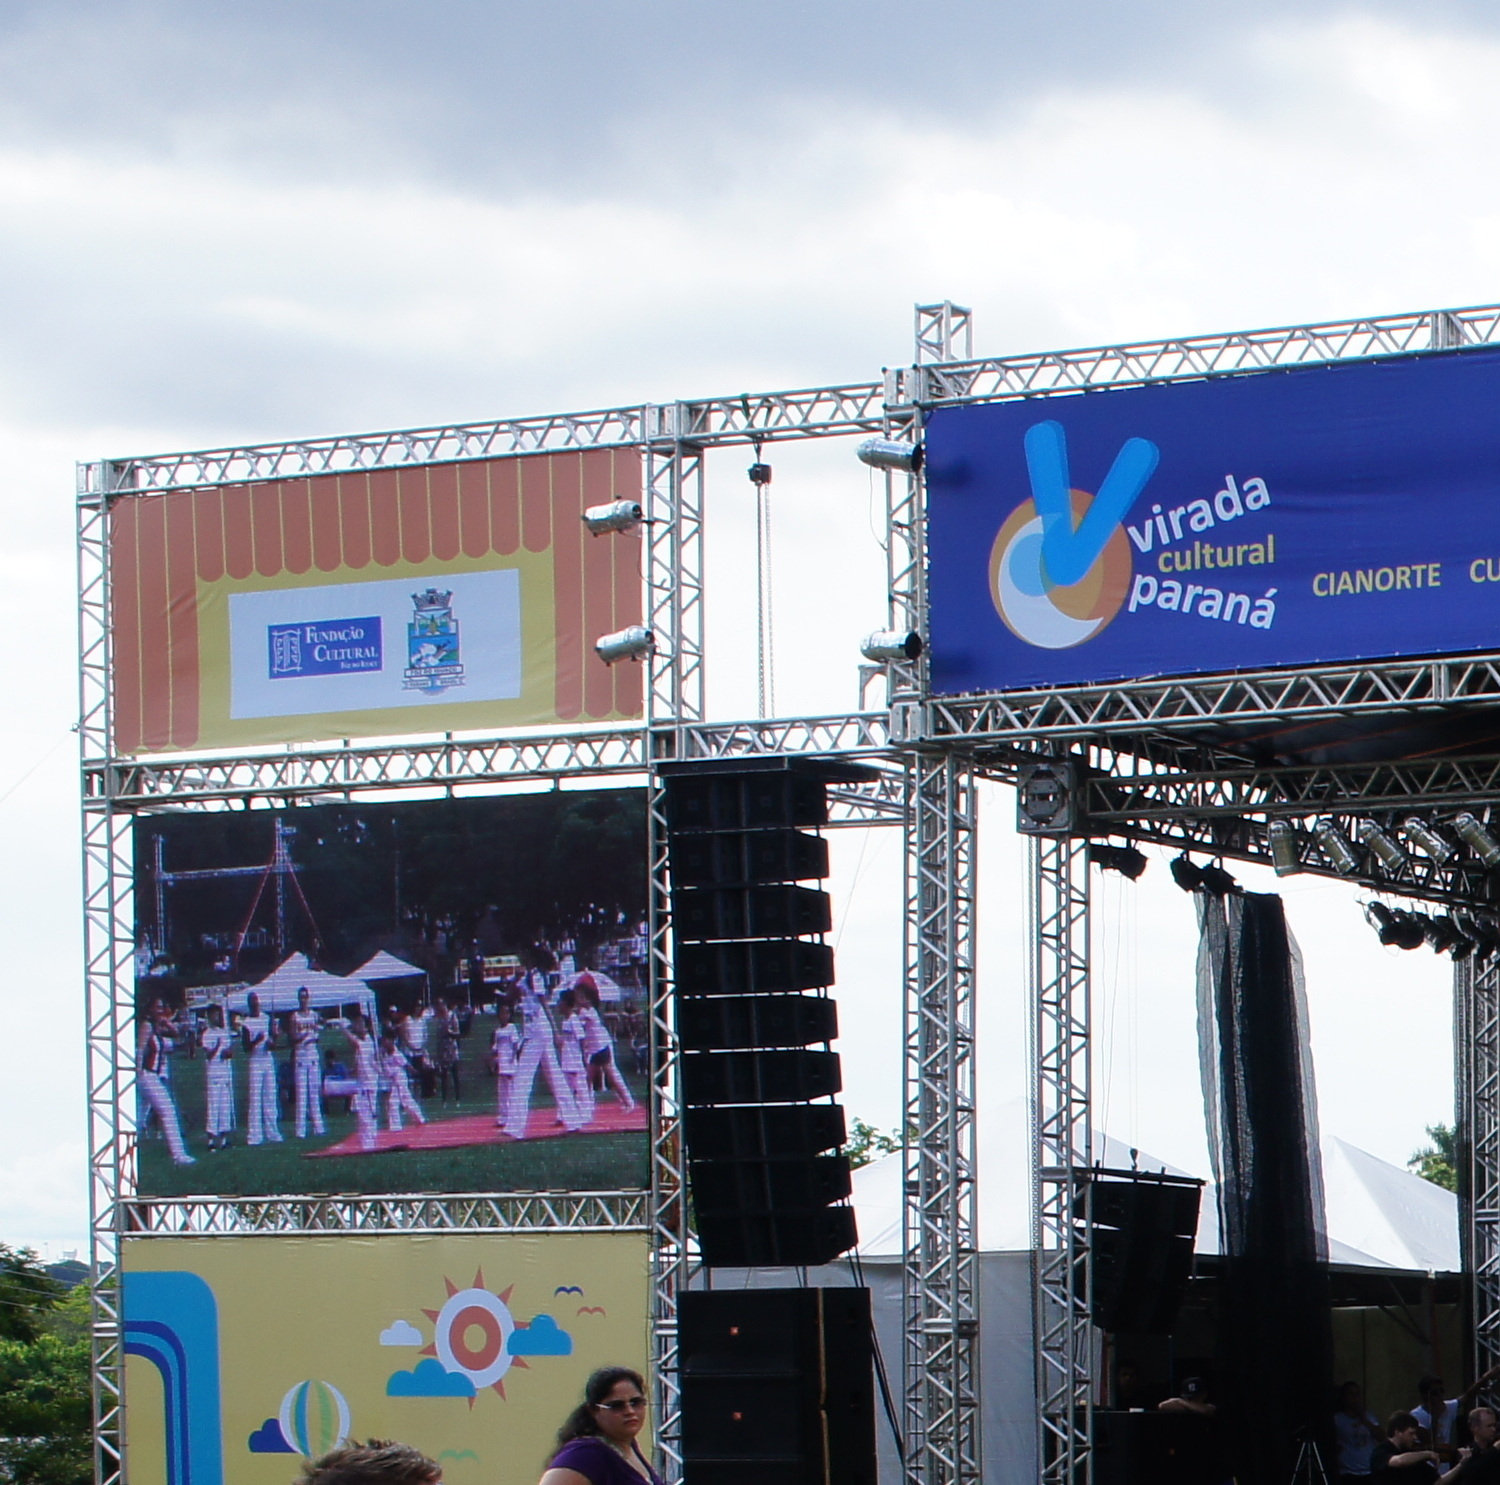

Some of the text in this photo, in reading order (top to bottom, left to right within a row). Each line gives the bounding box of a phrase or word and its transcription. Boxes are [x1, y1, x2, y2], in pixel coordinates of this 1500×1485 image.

[1130, 473, 1273, 557] virada
[1158, 534, 1275, 574] cultural
[1128, 568, 1278, 630] paraná
[1312, 563, 1442, 597] CIANORTE
